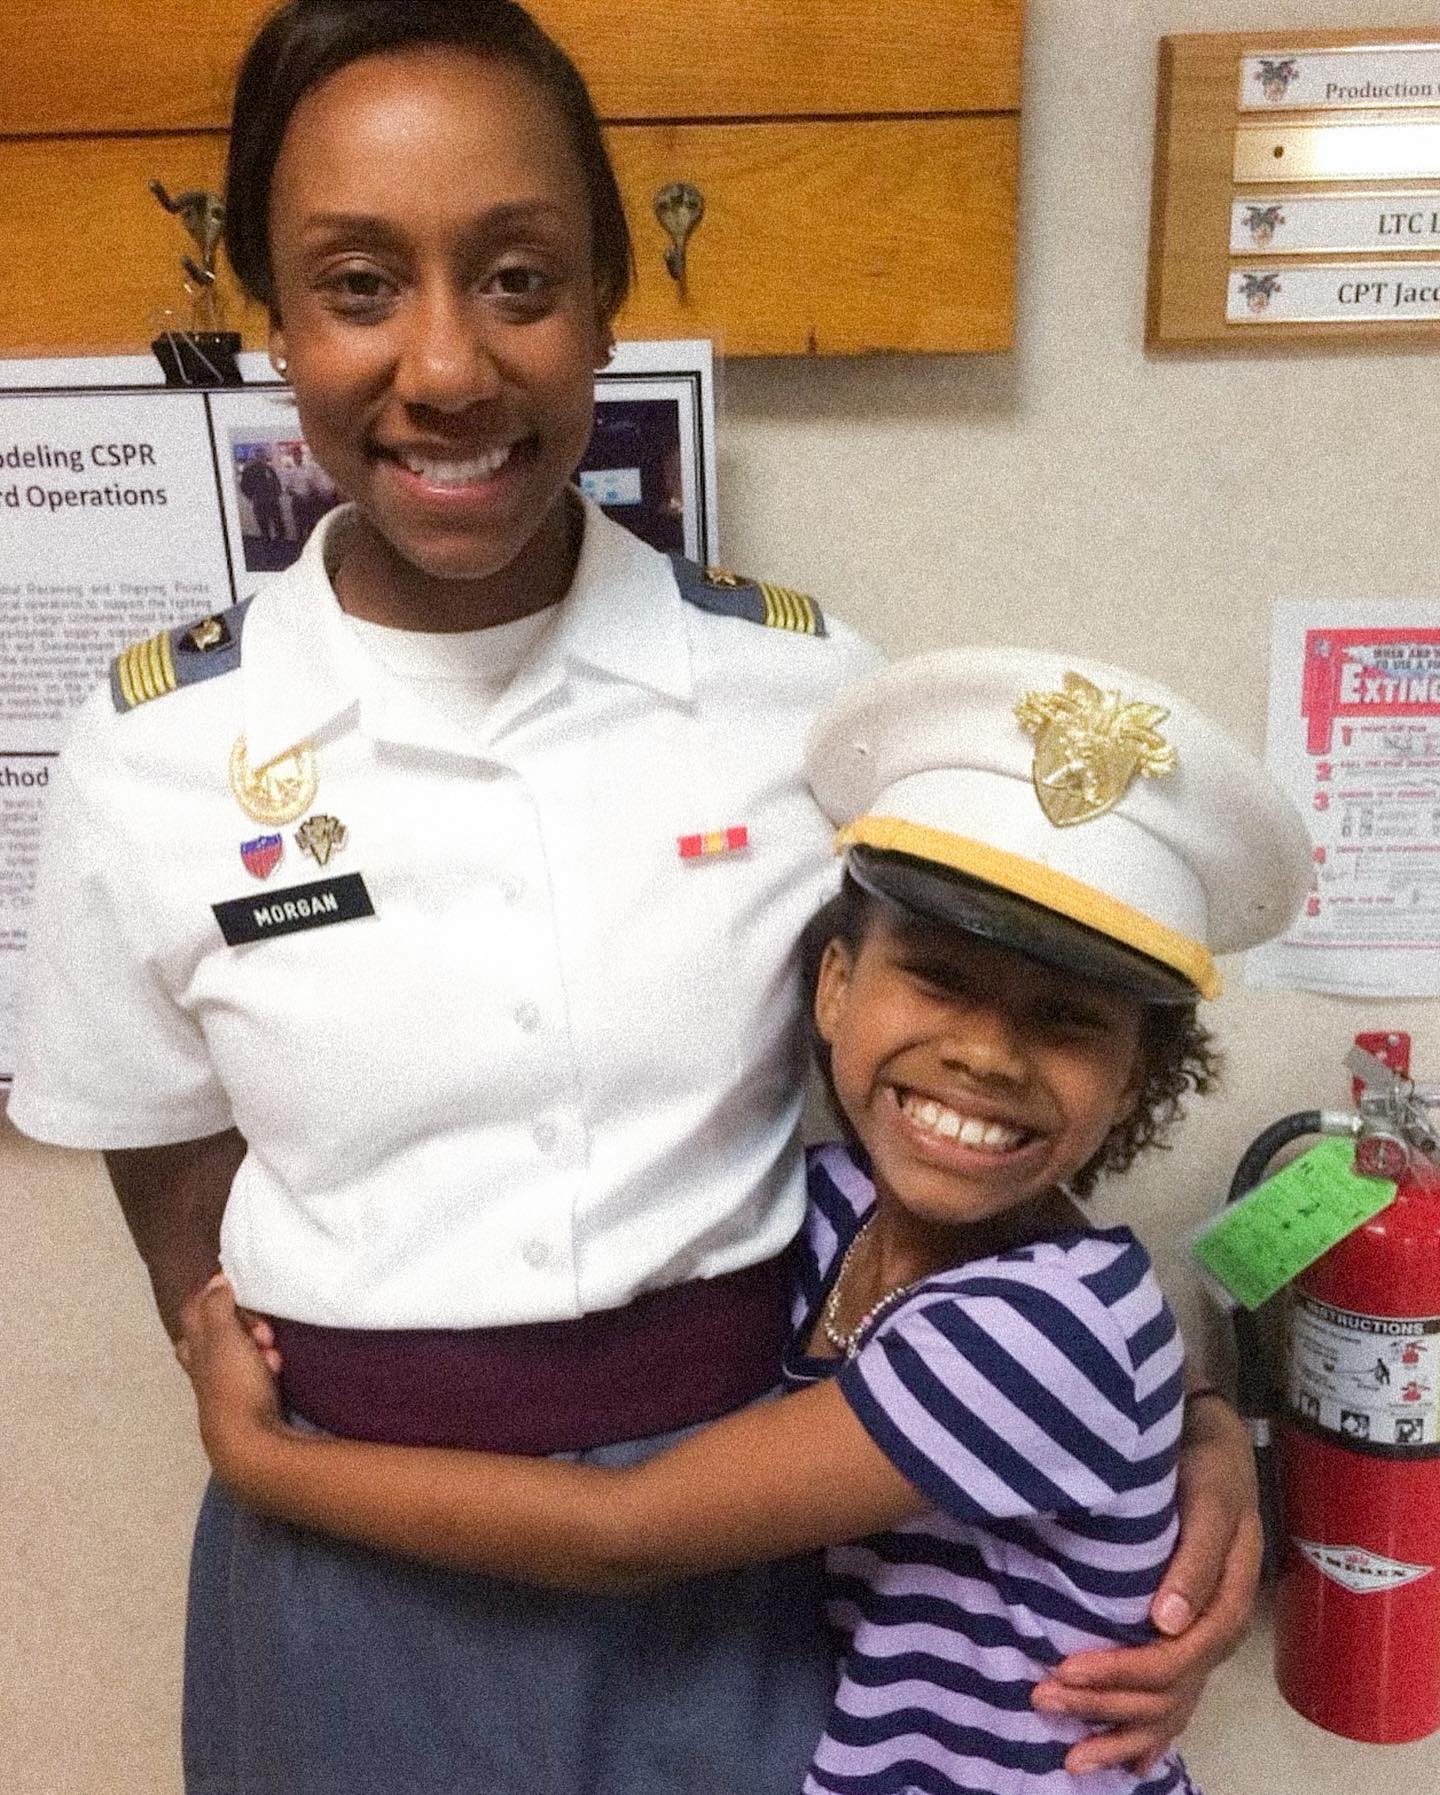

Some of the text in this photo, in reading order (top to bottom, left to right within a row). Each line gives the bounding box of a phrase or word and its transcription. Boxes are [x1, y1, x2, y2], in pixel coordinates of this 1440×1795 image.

[1325, 81, 1432, 99] Production
[1378, 212, 1423, 235] LTC
[1338, 282, 1389, 304] CPT
[91, 443, 156, 468] CSPR
[0, 484, 168, 512] d Operations
[252, 892, 340, 927] MORGAN
